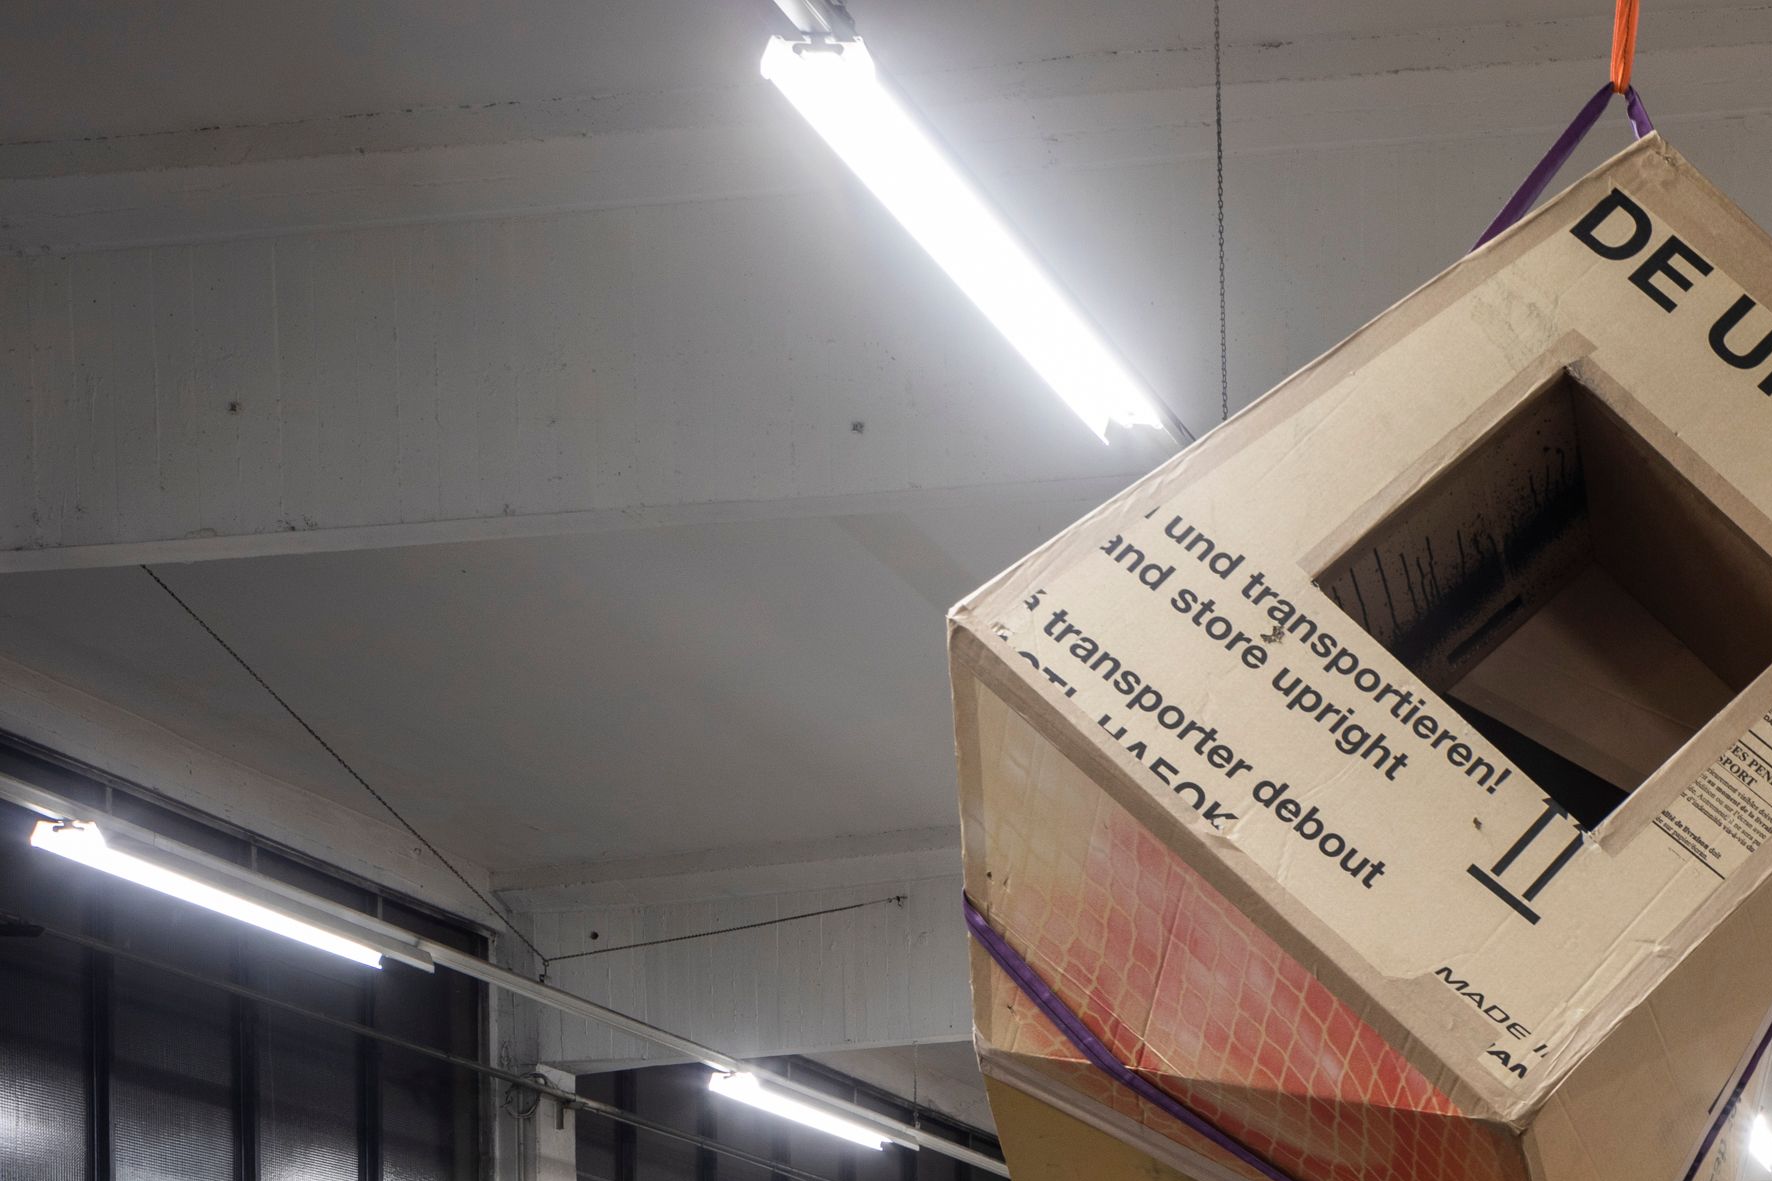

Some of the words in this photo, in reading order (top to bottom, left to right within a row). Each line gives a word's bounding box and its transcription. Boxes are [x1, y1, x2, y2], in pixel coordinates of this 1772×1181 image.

[1569, 187, 1714, 314] DE
[1043, 610, 1252, 781] transporter
[1252, 777, 1387, 889] debout
[1164, 515, 1245, 580] und
[1248, 570, 1511, 794] transportieren!
[1171, 584, 1269, 669] store
[1272, 666, 1409, 781] upright
[1435, 967, 1532, 1040] MADE
